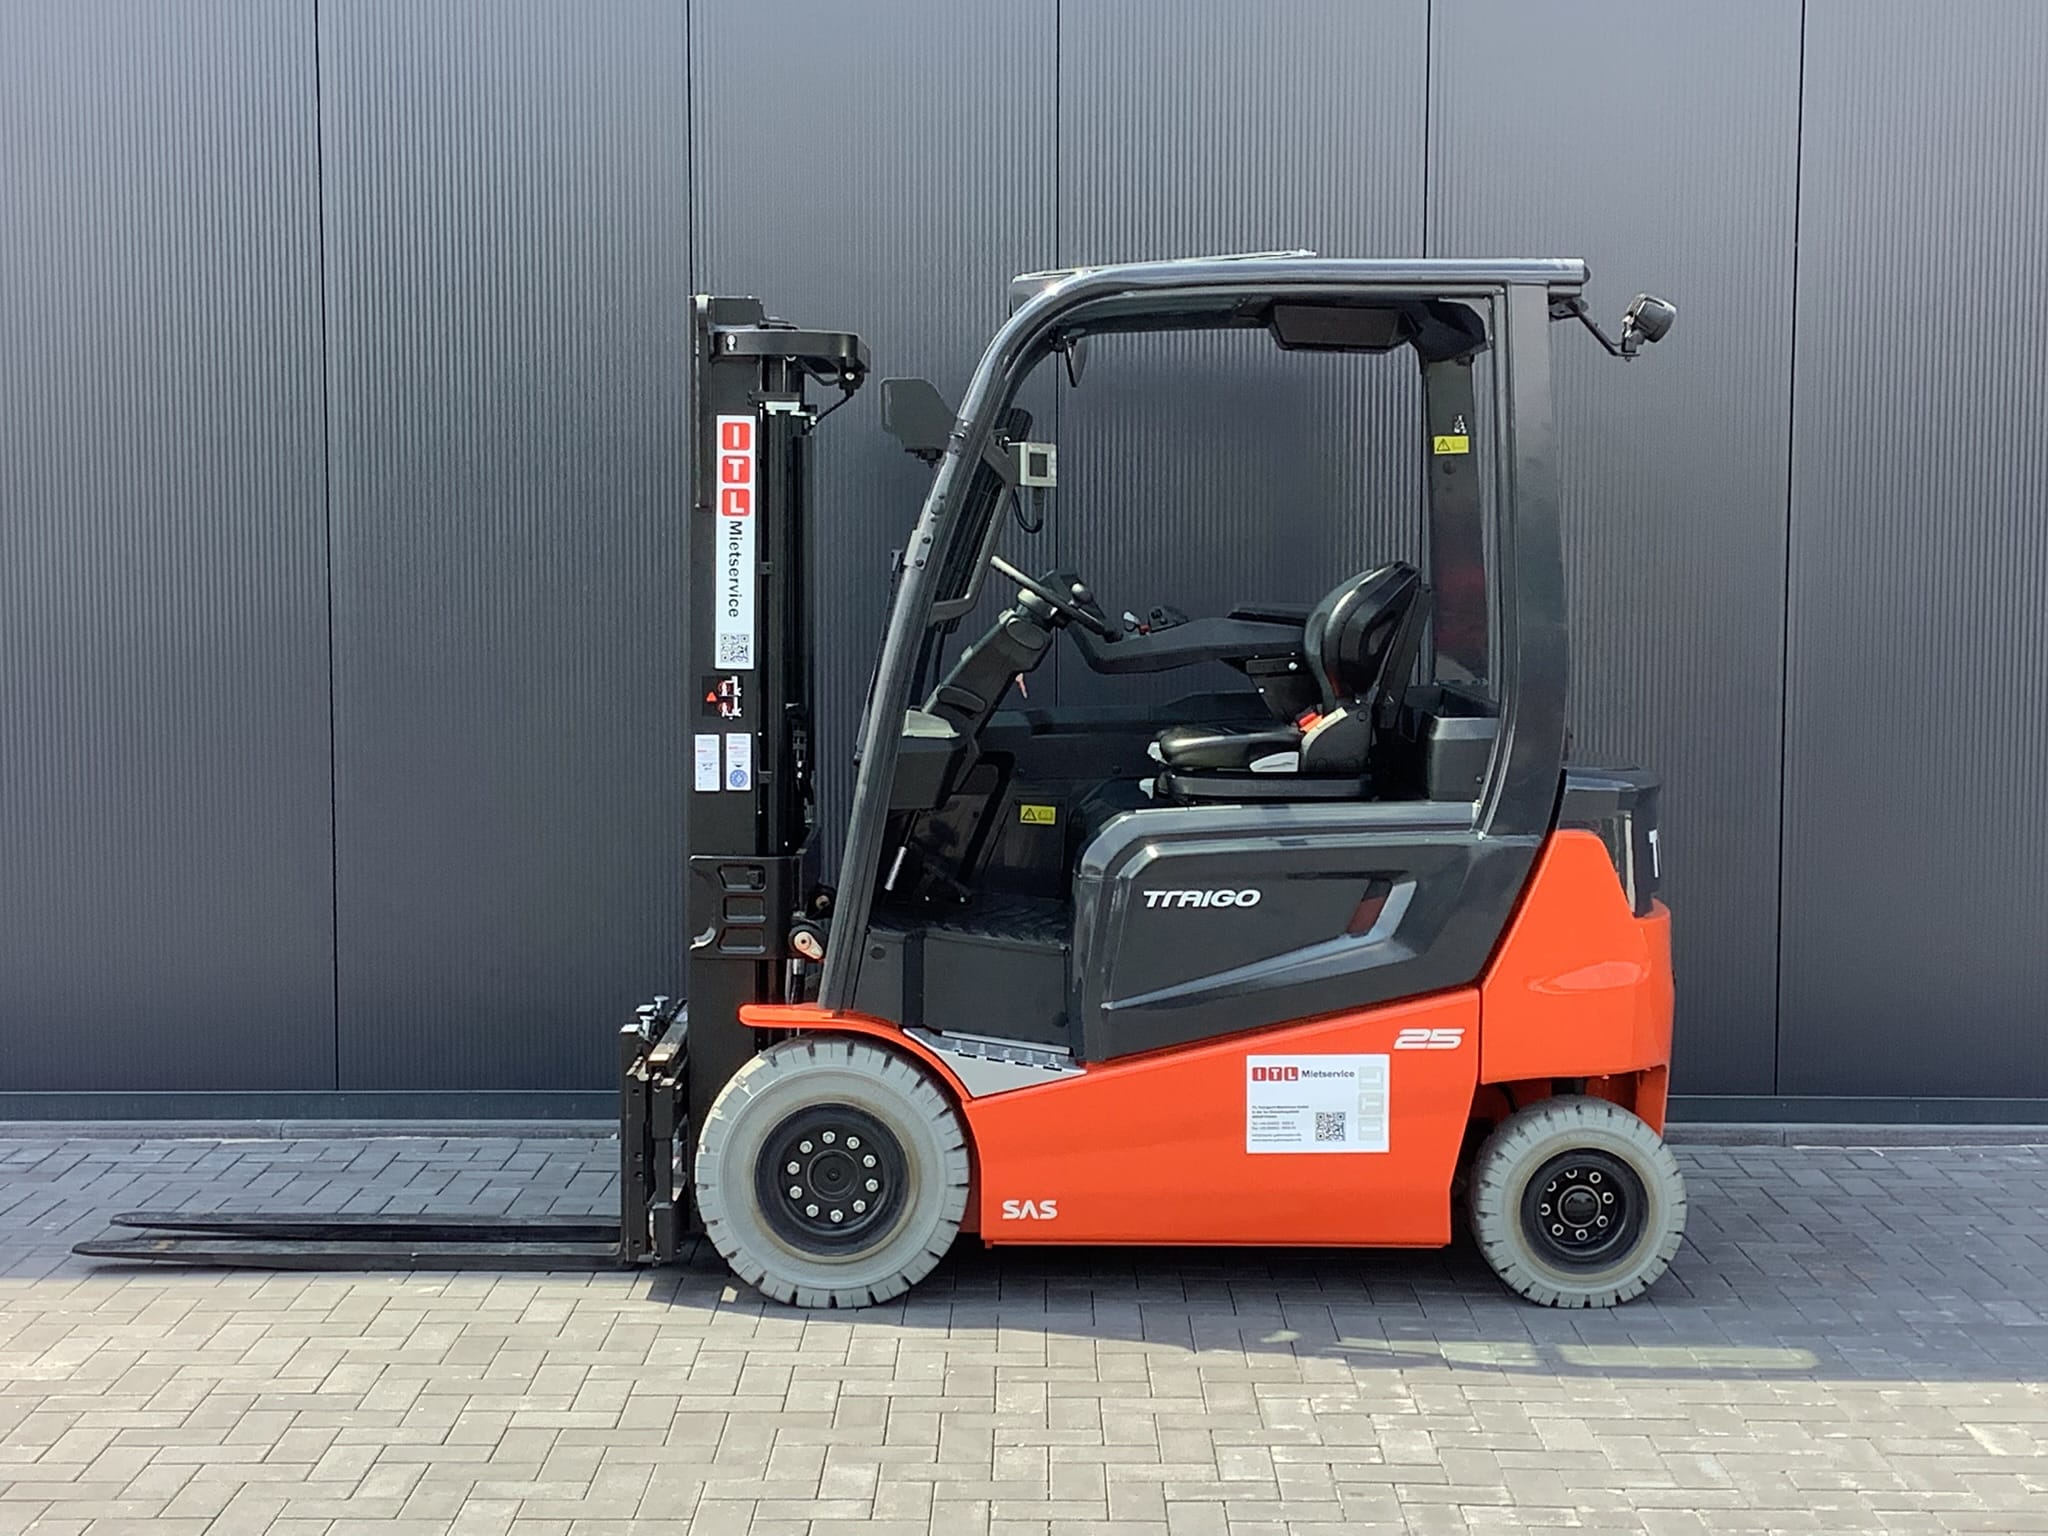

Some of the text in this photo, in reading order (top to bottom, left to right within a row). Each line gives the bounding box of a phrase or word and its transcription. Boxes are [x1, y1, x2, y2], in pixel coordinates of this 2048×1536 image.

[725, 423, 748, 618] ITL Mietservice
[1393, 1028, 1465, 1050] 25
[1254, 1068, 1356, 1081] ITL Mietservice
[1002, 1199, 1058, 1219] SAS
